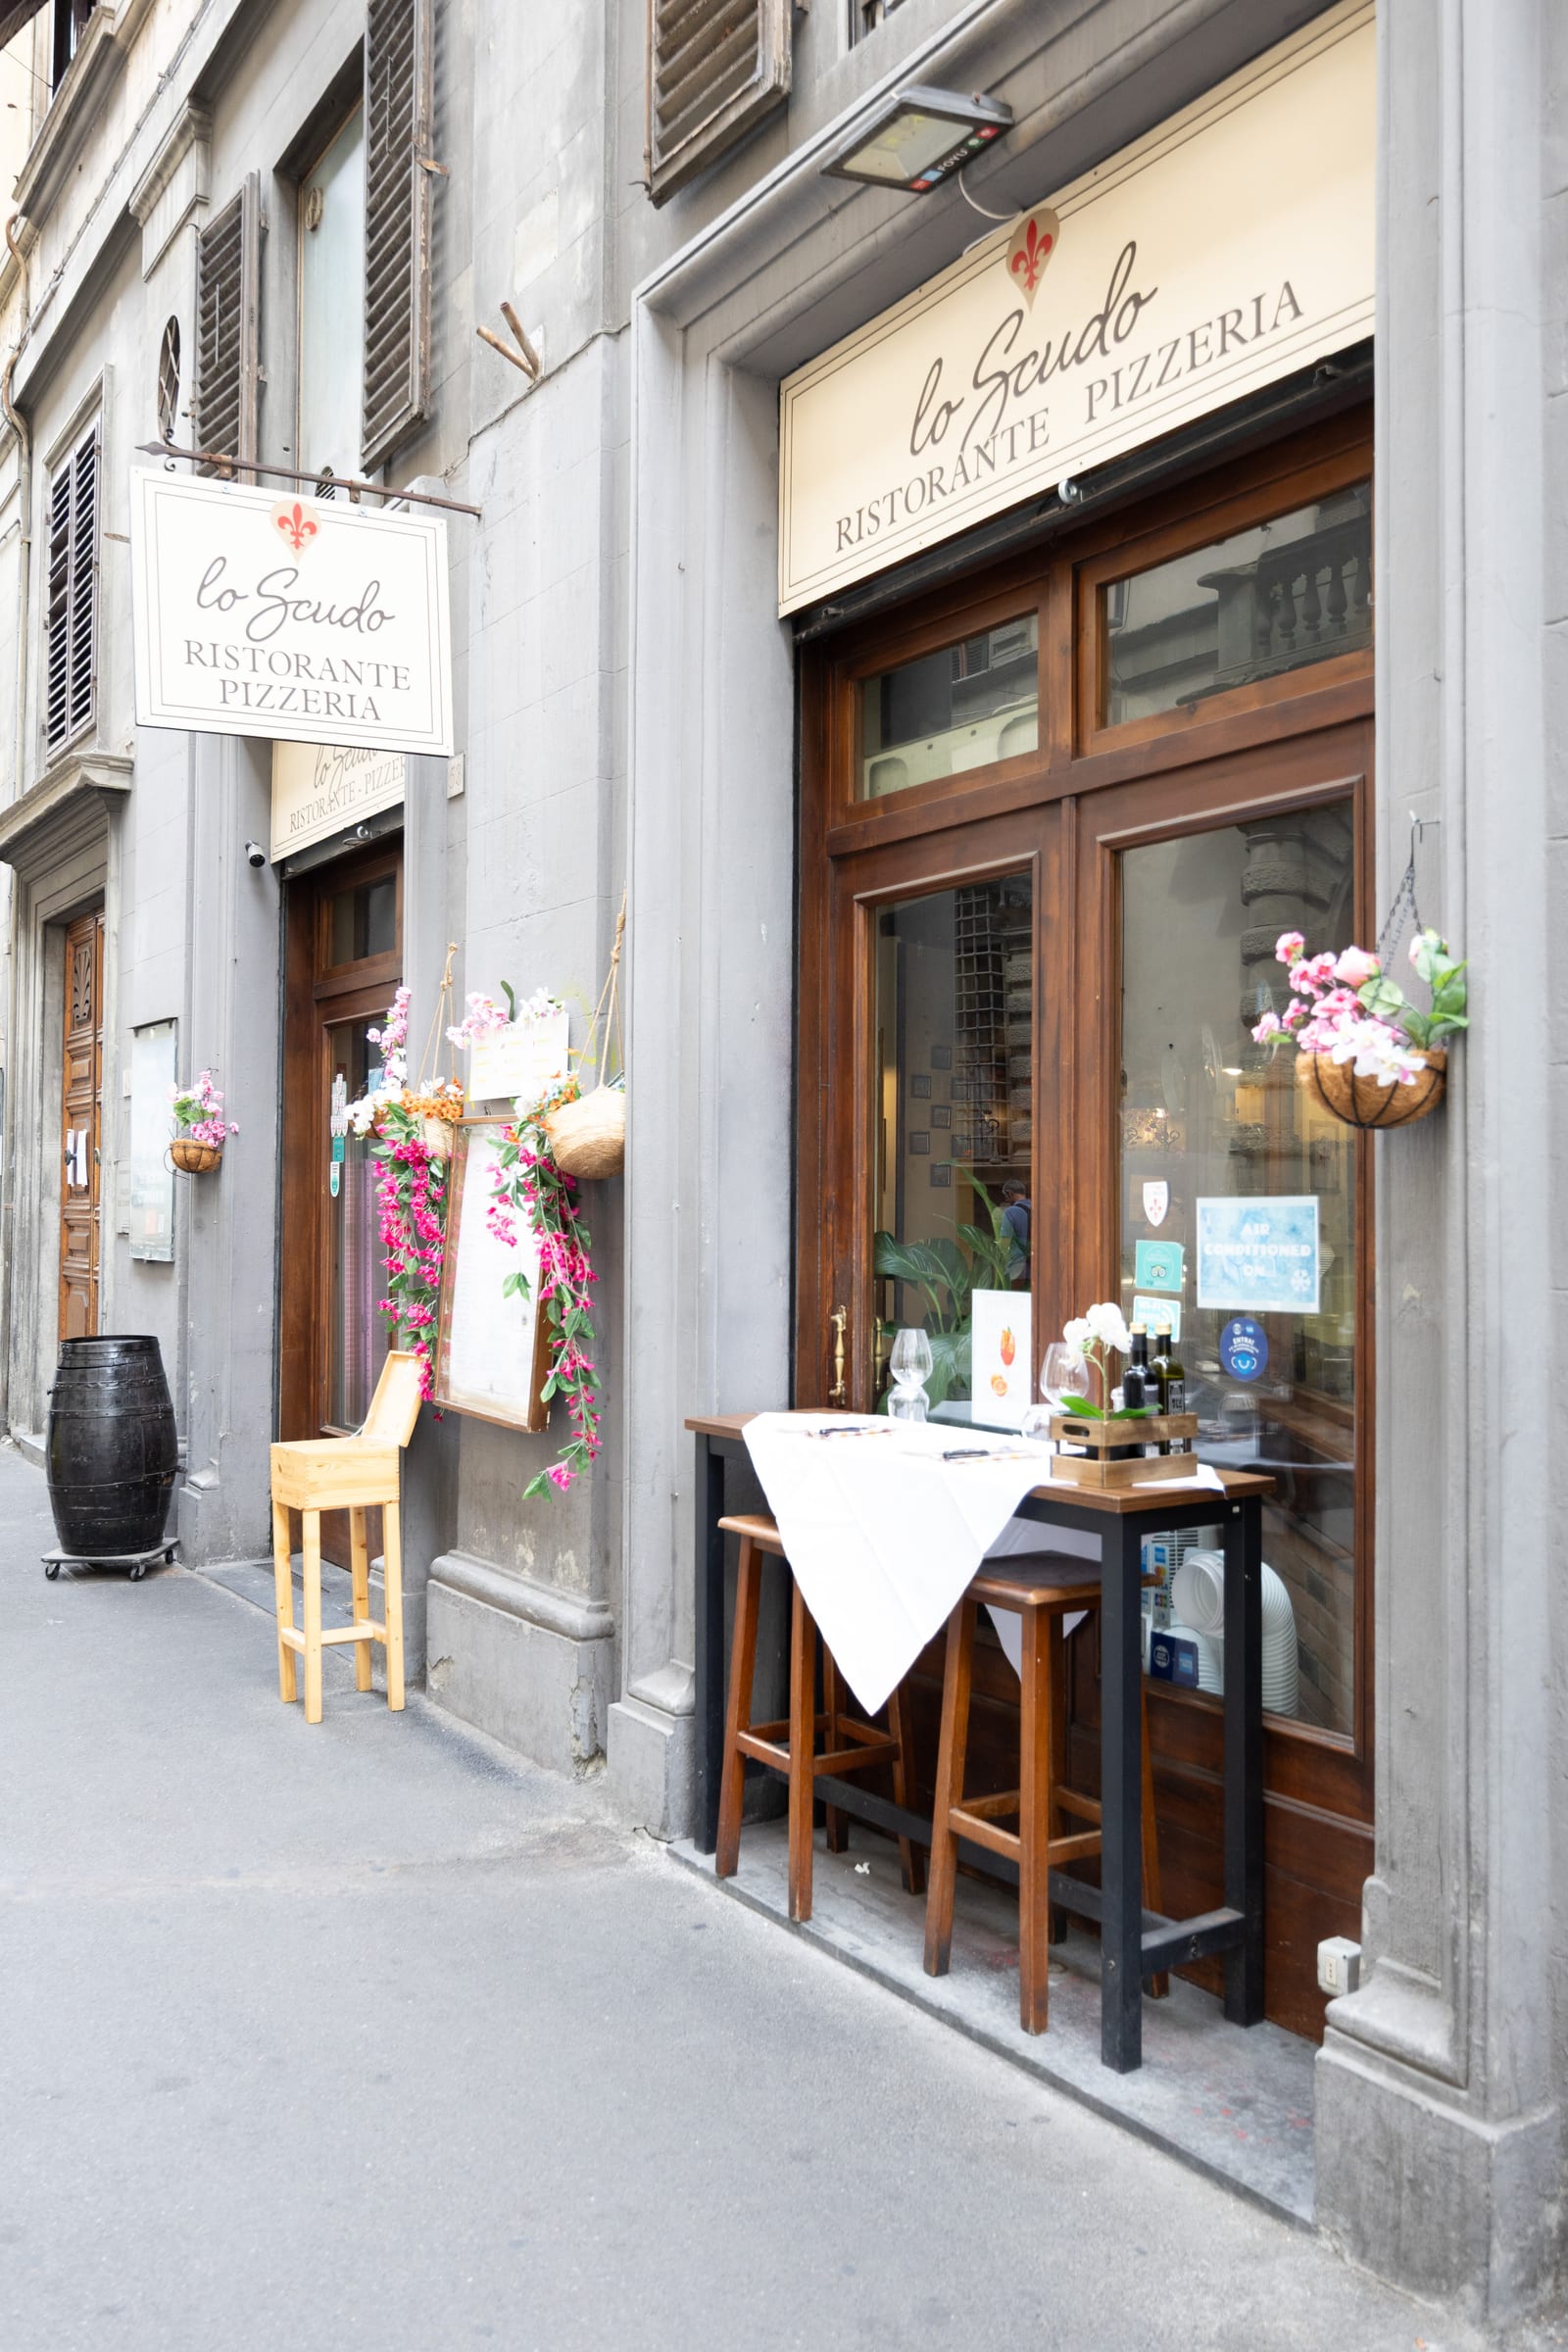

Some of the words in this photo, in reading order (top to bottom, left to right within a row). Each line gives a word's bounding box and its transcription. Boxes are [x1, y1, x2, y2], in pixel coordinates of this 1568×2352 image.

[910, 357, 964, 457] lo
[958, 240, 1158, 455] Scudo
[834, 407, 1052, 553] RISTORANTE
[1083, 279, 1305, 424] PIZZERIA
[196, 556, 248, 612] lo
[245, 567, 396, 643] Scudo
[183, 639, 411, 691] RISTORANTE
[219, 678, 382, 721] PIZZERIA
[290, 780, 356, 833] RISTORANTE
[1204, 1244, 1311, 1257] CONDITIONED
[1241, 1223, 1270, 1236] AIR
[1243, 1263, 1266, 1277] ON
